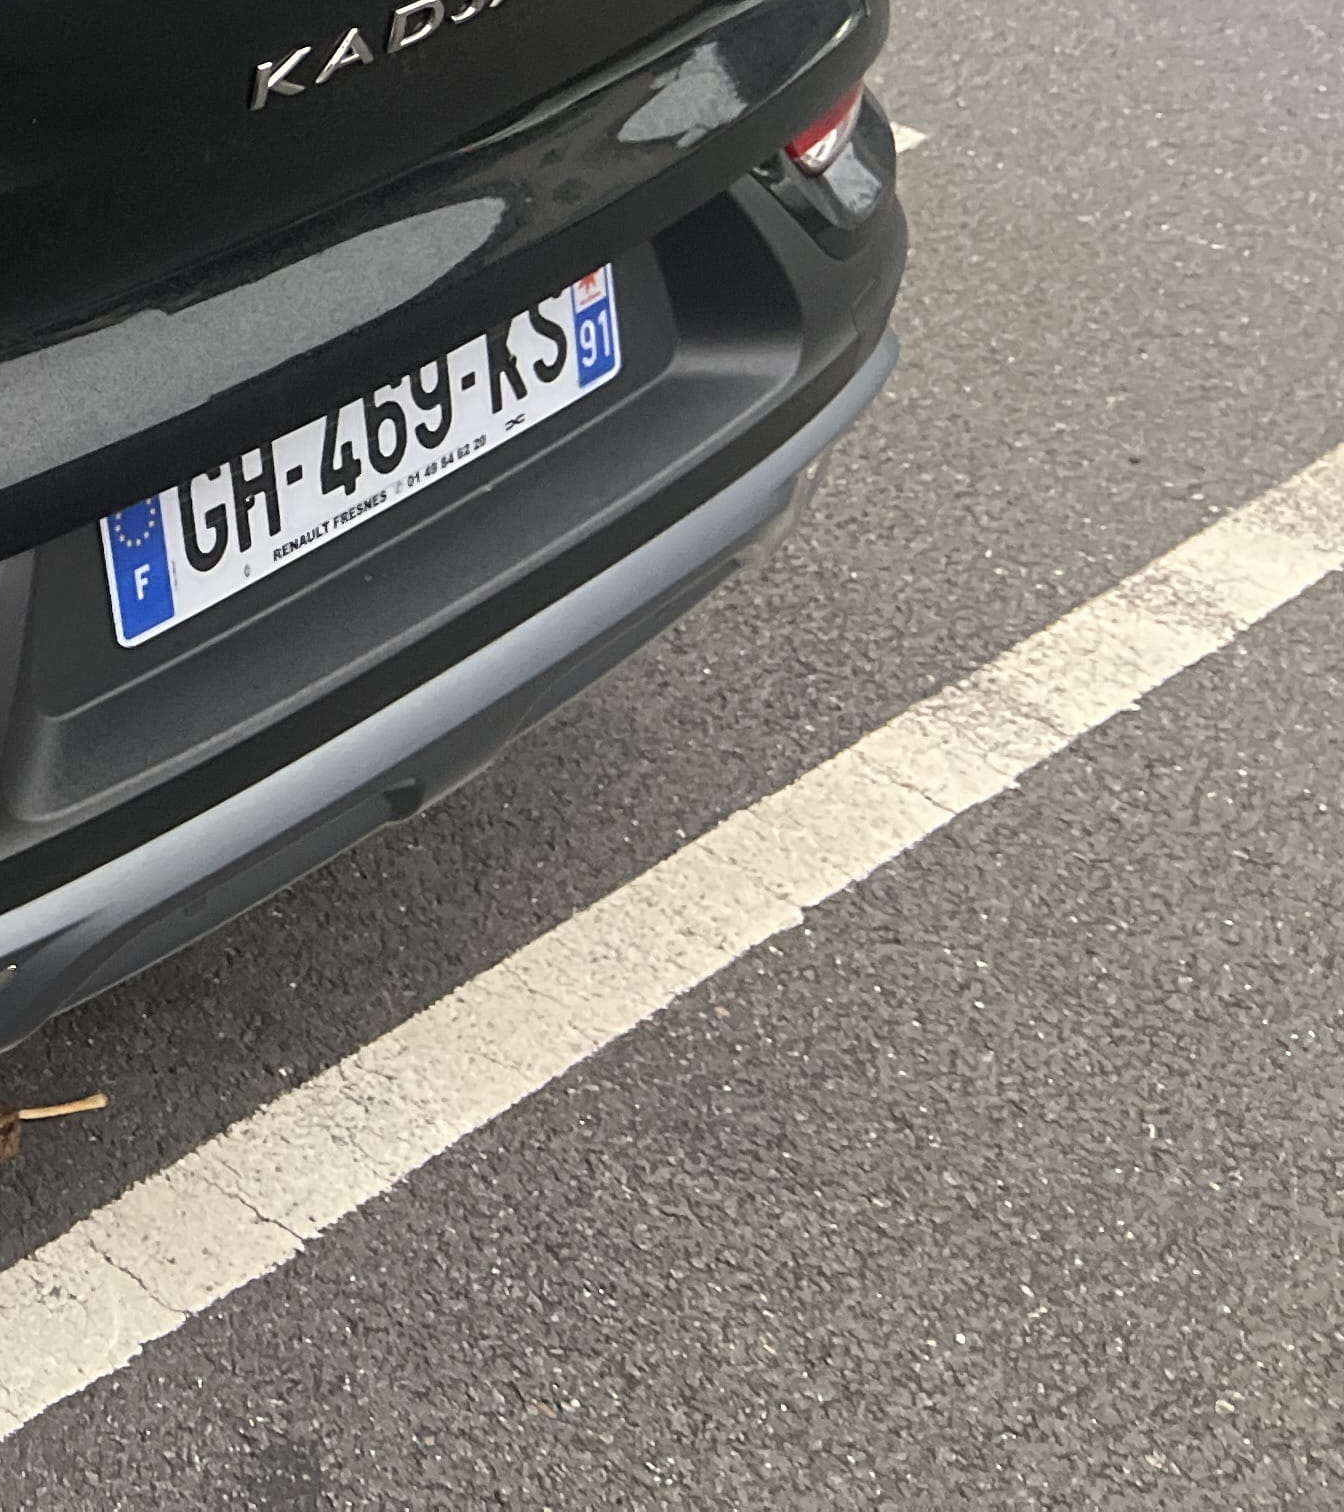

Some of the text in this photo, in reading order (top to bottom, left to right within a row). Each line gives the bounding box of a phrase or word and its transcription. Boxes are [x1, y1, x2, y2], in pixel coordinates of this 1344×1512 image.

[579, 308, 612, 368] 91
[176, 296, 568, 573] GH-469-KS
[272, 520, 330, 562] RENAULT
[333, 489, 388, 530] FRESNES
[407, 471, 421, 488] 01
[134, 563, 151, 601] F
